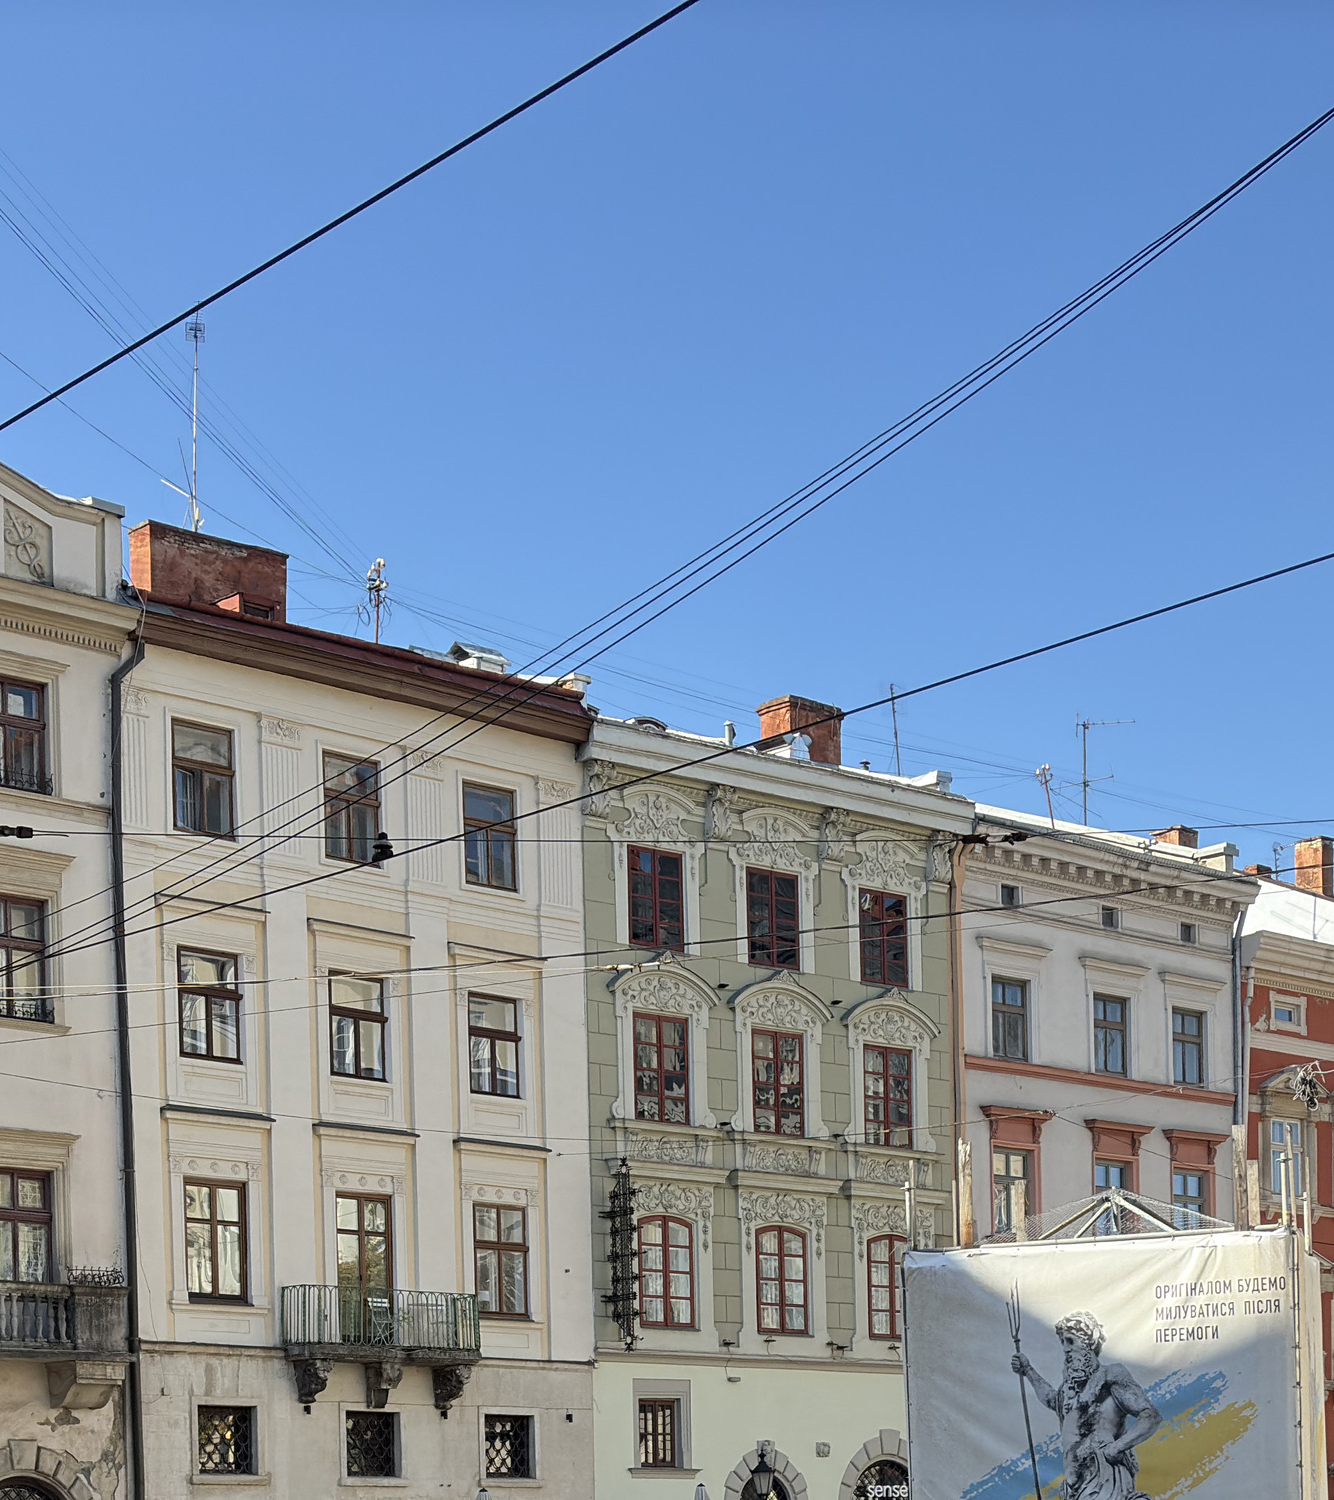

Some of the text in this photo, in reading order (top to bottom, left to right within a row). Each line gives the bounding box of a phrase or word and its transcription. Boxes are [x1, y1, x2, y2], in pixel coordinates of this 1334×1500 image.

[1155, 1276, 1286, 1299] ОРИГІНАЛОМ БУДЕМО
[1155, 1299, 1281, 1321] МИЛУВАТИСЯ ПІСЛЯ
[1155, 1325, 1219, 1343] ПЕРЕМОГИ
[867, 1485, 908, 1497] sense
